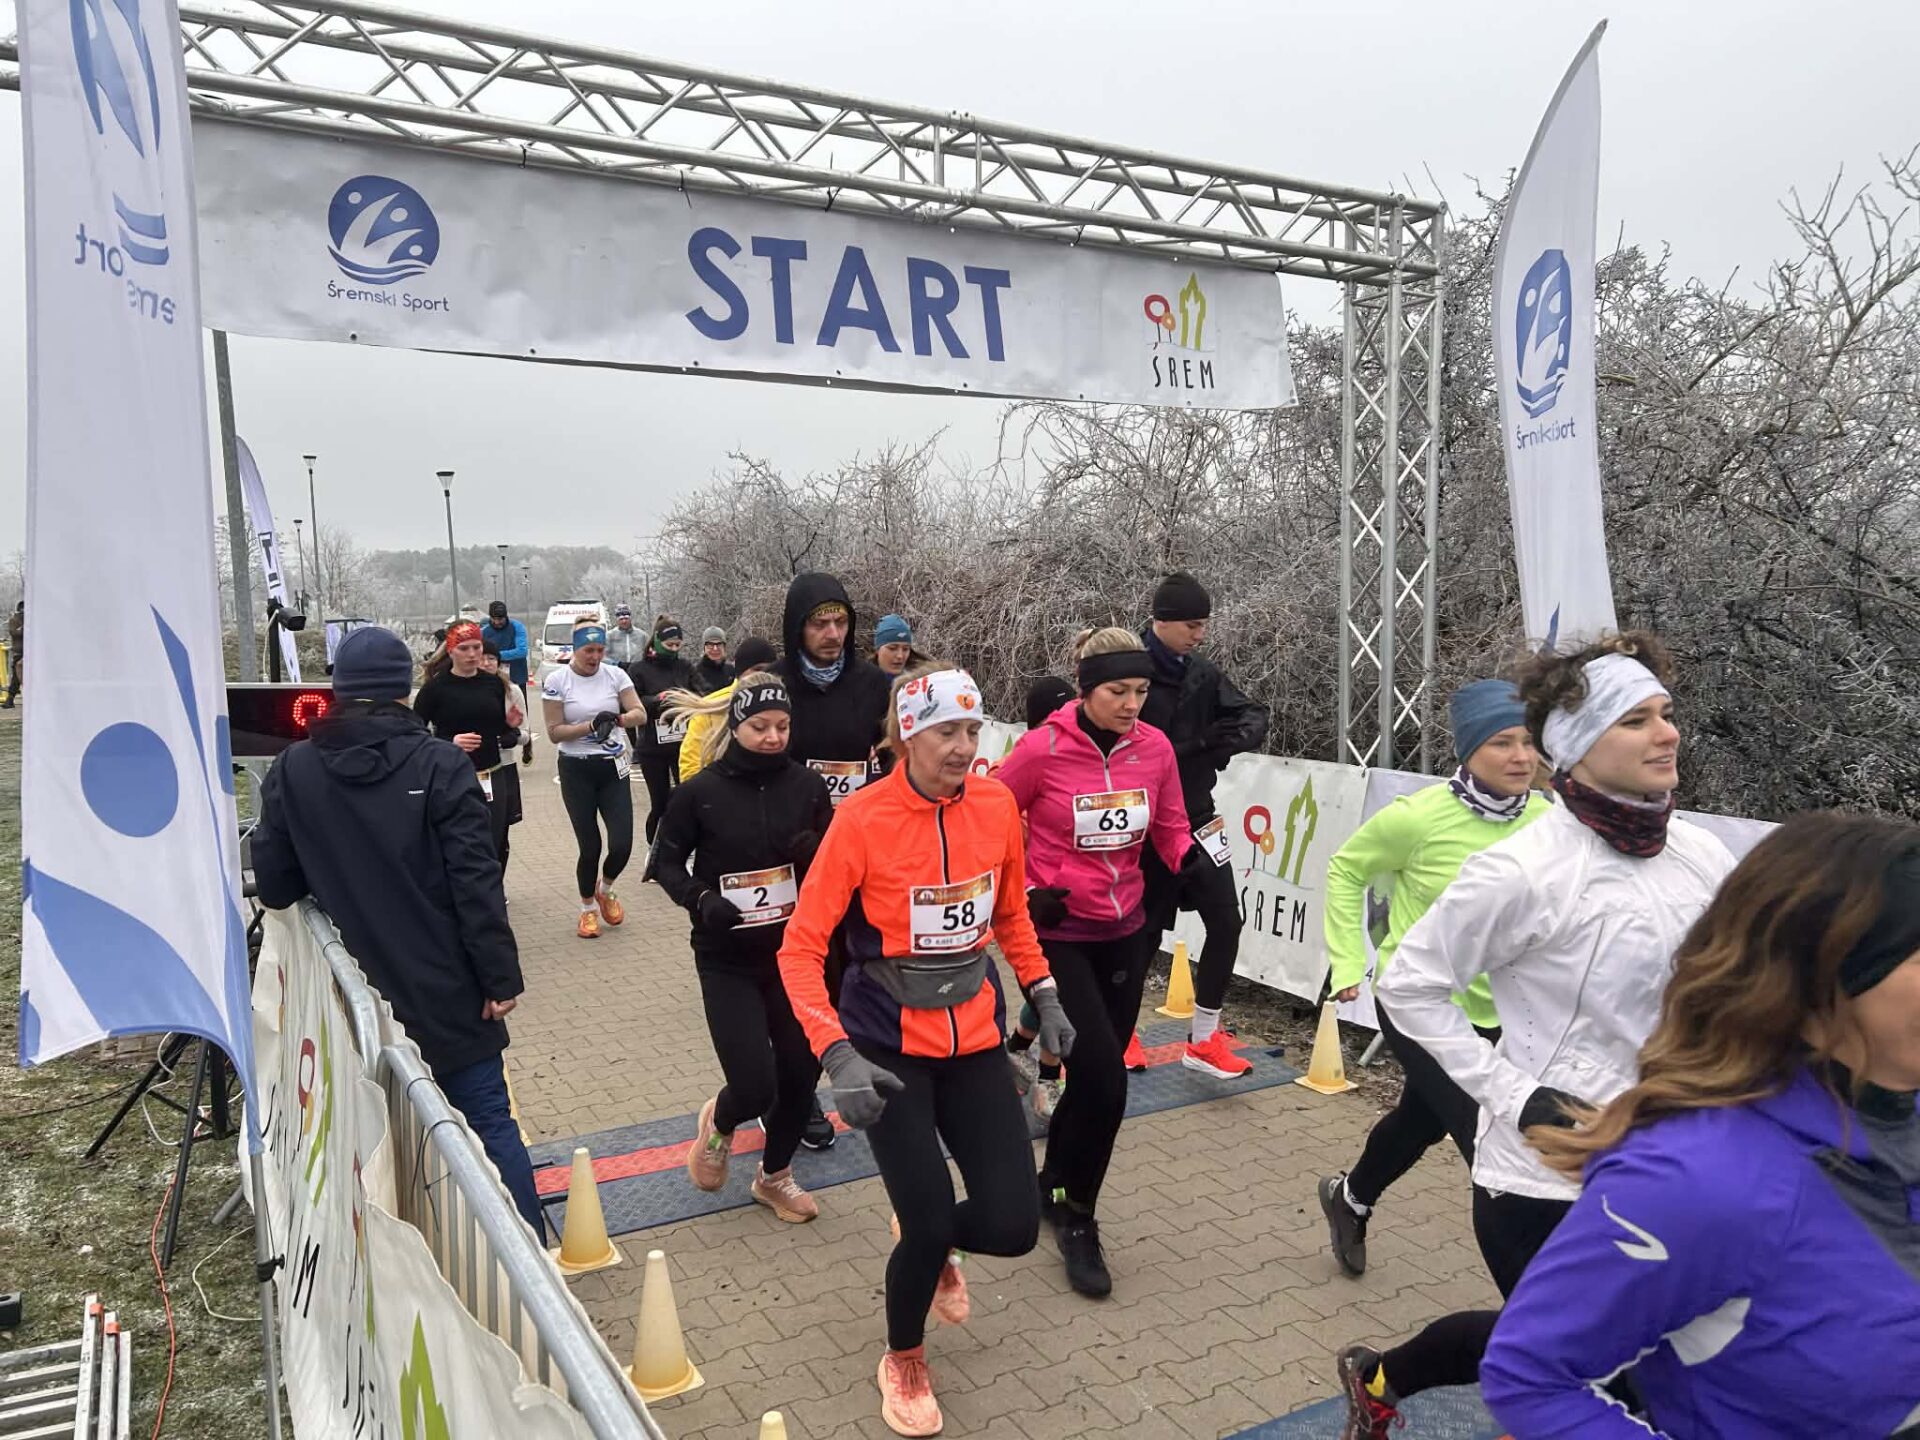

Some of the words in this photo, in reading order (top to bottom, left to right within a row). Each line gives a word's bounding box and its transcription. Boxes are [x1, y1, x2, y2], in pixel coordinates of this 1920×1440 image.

[327, 280, 397, 307] Śremski
[402, 293, 450, 312] Sport
[685, 227, 1011, 362] START
[1152, 341, 1215, 390] ŚREM
[759, 688, 789, 702] RU
[826, 775, 850, 794] 96
[1098, 808, 1129, 832] 63
[753, 886, 770, 908] 2
[942, 900, 976, 931] 58
